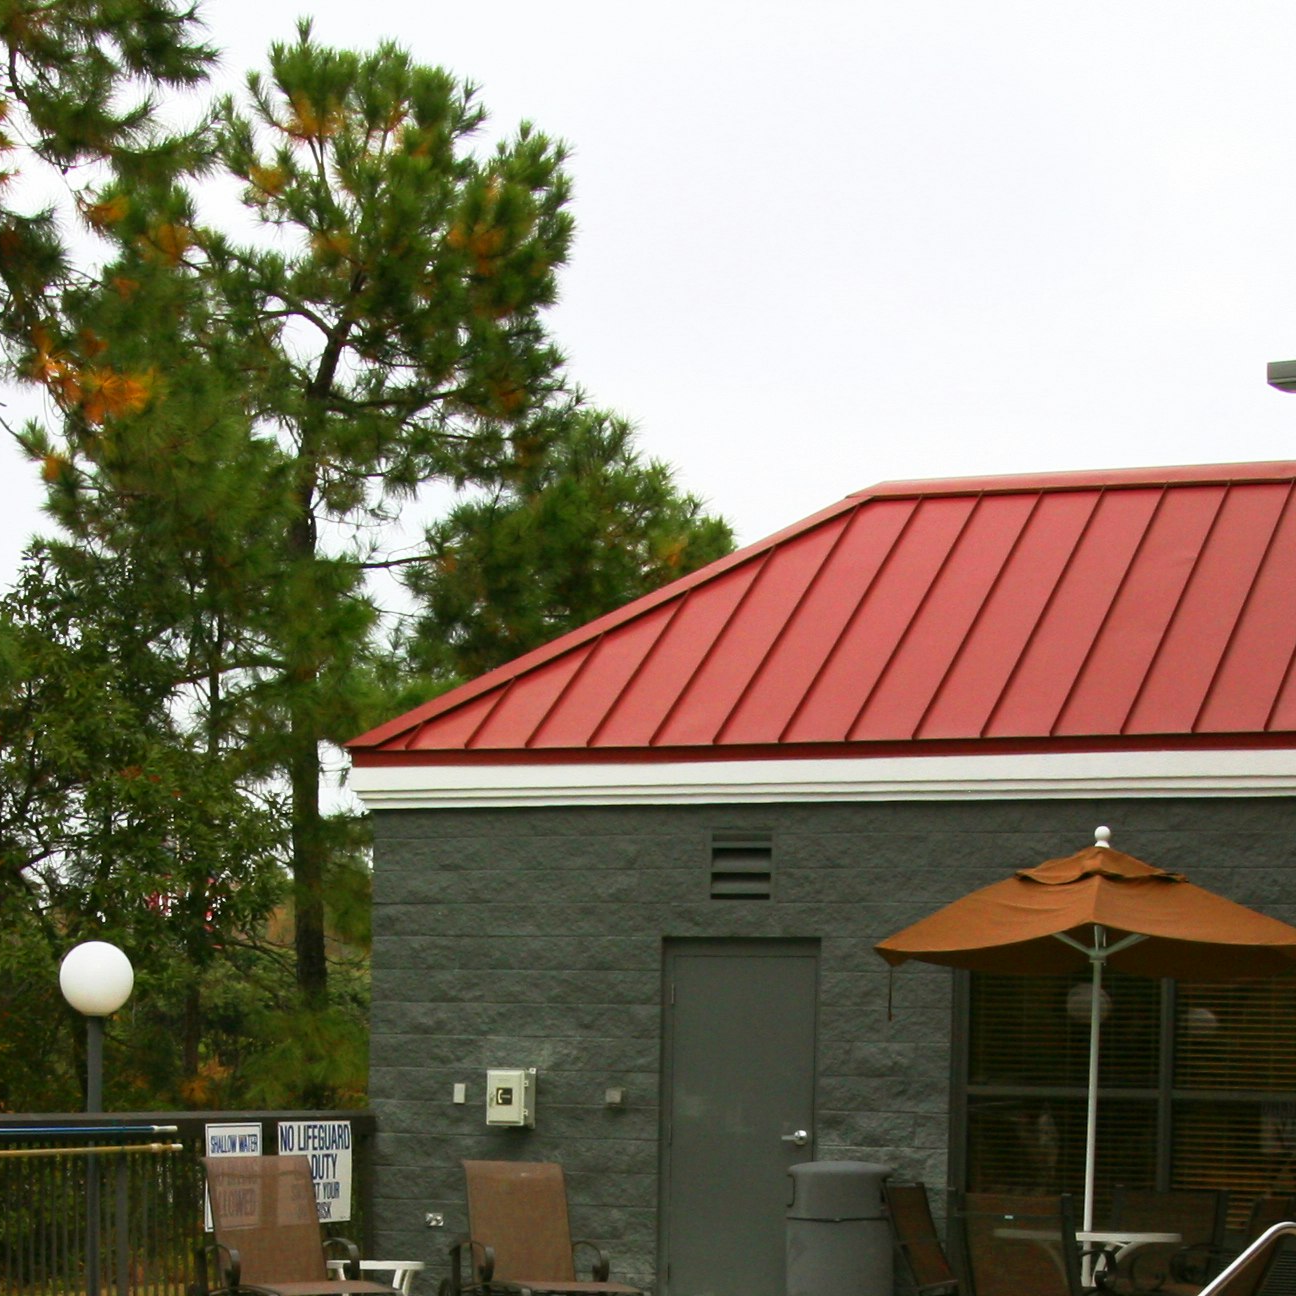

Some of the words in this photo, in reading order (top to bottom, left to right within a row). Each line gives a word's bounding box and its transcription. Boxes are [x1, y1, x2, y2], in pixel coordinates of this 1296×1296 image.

[211, 1135, 236, 1154] SHALLOW
[238, 1134, 258, 1152] WATER
[280, 1125, 294, 1152] NO
[298, 1124, 350, 1151] LIFEGUARD
[311, 1153, 337, 1179] DUTY
[323, 1182, 340, 1199] YOUR
